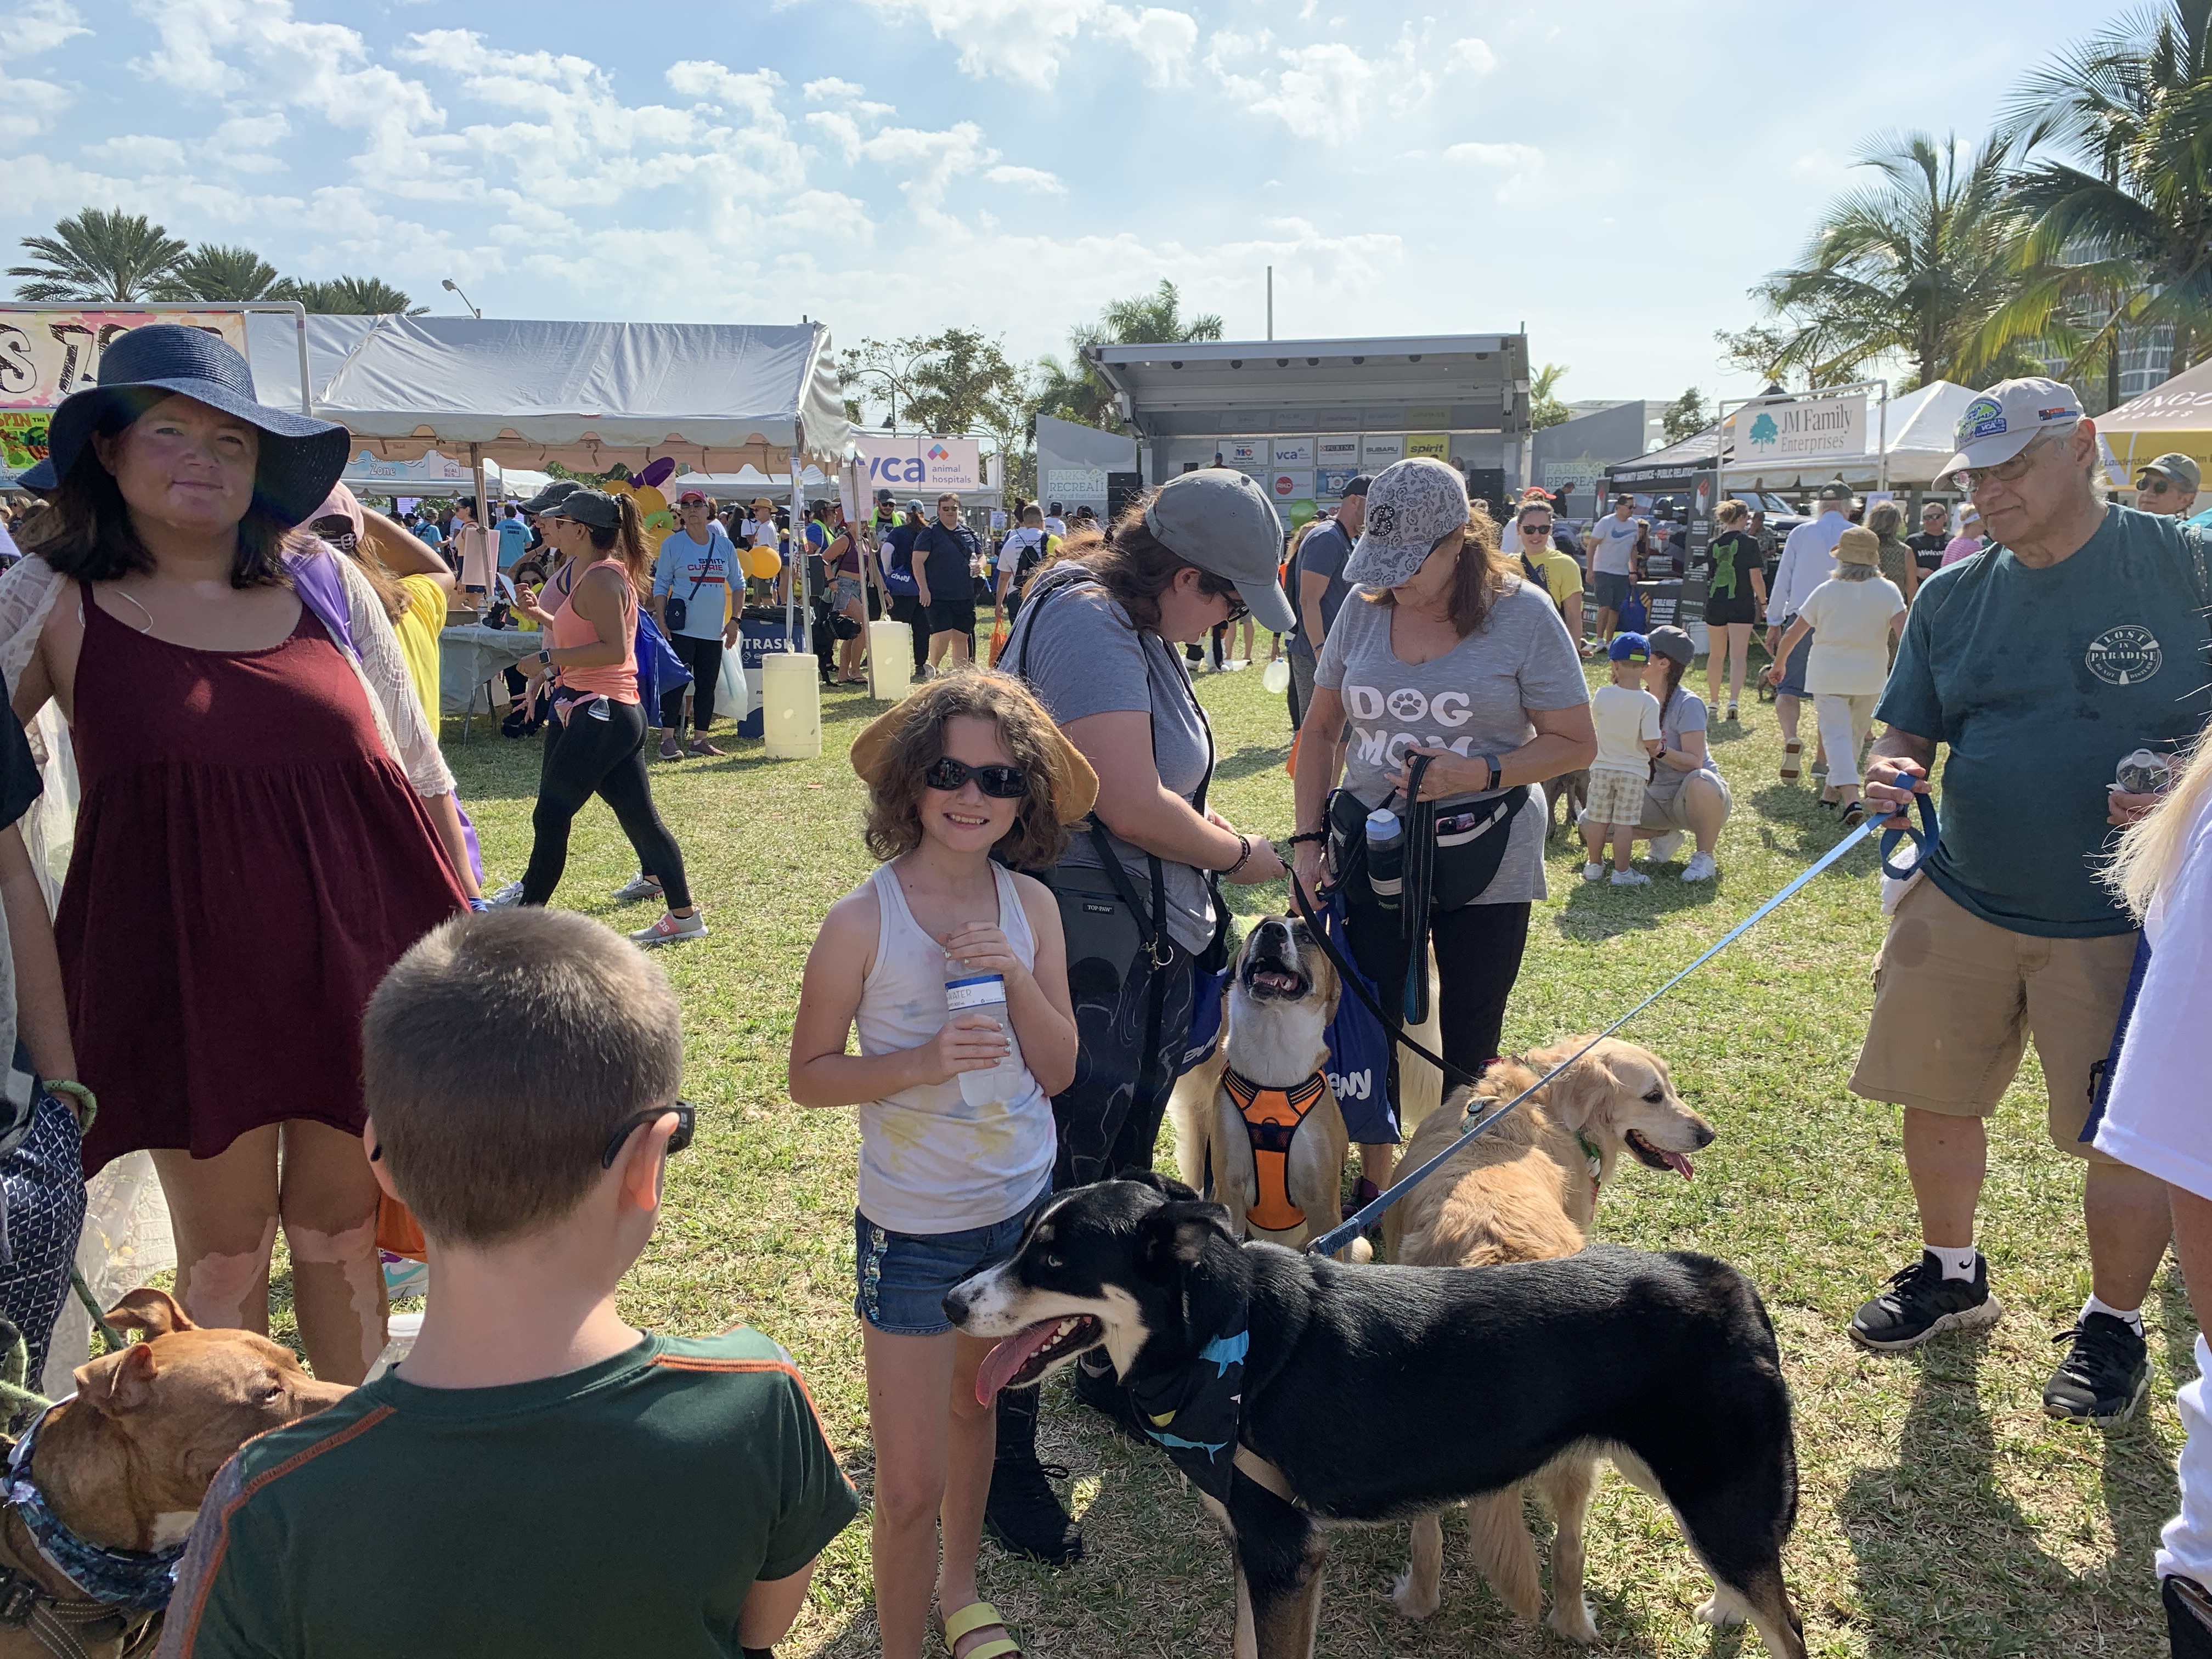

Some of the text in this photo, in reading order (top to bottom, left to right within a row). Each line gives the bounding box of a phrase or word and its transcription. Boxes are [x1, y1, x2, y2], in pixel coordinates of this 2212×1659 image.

[1782, 403, 1853, 434] JM Family
[2116, 410, 2193, 421] HOMES
[1410, 444, 1444, 454] spirit
[1781, 433, 1845, 454] Enterprises
[1276, 451, 1298, 460] vca
[370, 464, 396, 476] Zone
[932, 464, 961, 472] animal
[1547, 464, 1588, 474] PARKS
[933, 475, 972, 485] hospitals
[1049, 471, 1086, 480] PARKS
[1369, 504, 1395, 536] B
[2103, 630, 2147, 644] LOST
[2091, 652, 2156, 662] PARADISE
[1348, 685, 1473, 727] DOG
[948, 989, 972, 1001] WATER
